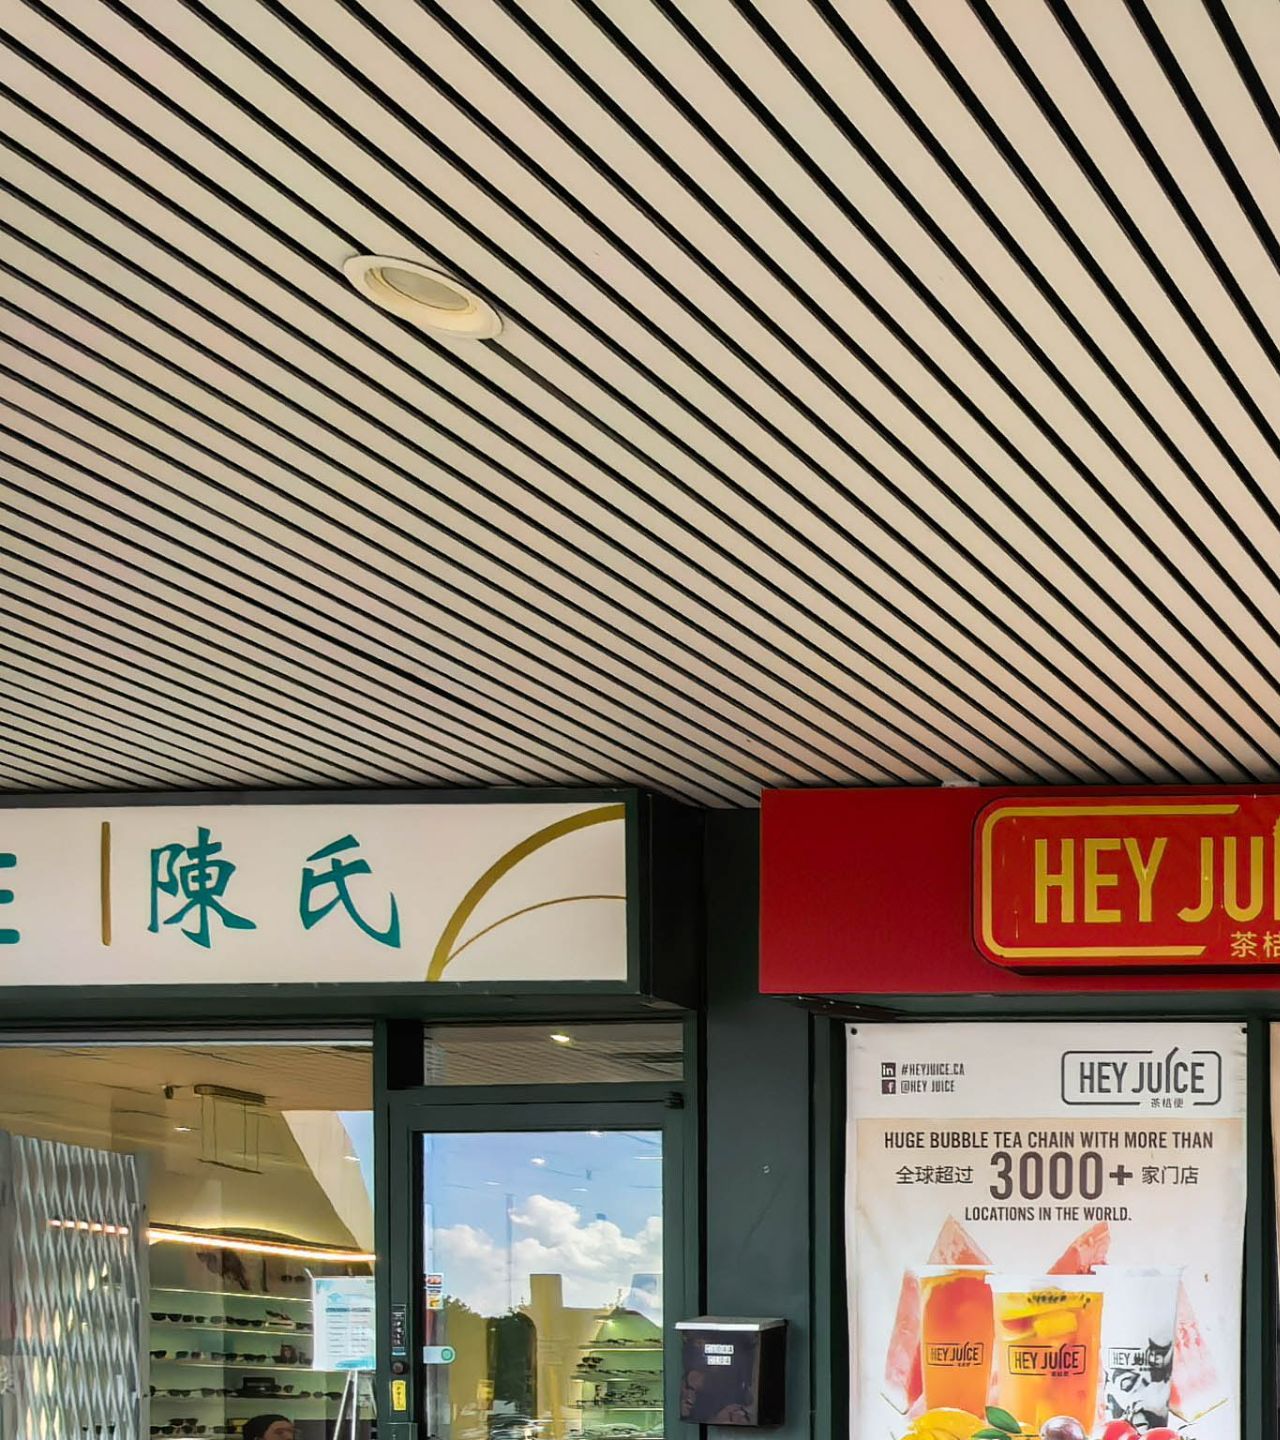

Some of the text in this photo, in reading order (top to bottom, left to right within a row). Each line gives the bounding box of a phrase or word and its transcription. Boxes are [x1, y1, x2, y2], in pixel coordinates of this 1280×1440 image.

[147, 826, 401, 948] 陳氏
[1034, 837, 1168, 923] HEY
[1080, 1046, 1205, 1093] HEY JUICE
[901, 1080, 927, 1094] @HEY
[931, 1080, 955, 1093] JUICE
[884, 1131, 1213, 1149] HUGE BUBBLE TEA CHAIN WITH MORE THAN
[895, 1165, 974, 1185] 全球超过
[1141, 1165, 1199, 1185] 家门店
[964, 1206, 1132, 1221] LOCATIONS IN THE WORLD.
[930, 1342, 978, 1361] HEY JUICE
[1015, 1344, 1079, 1370] HEY JUICE
[1113, 1353, 1131, 1366] HEY
